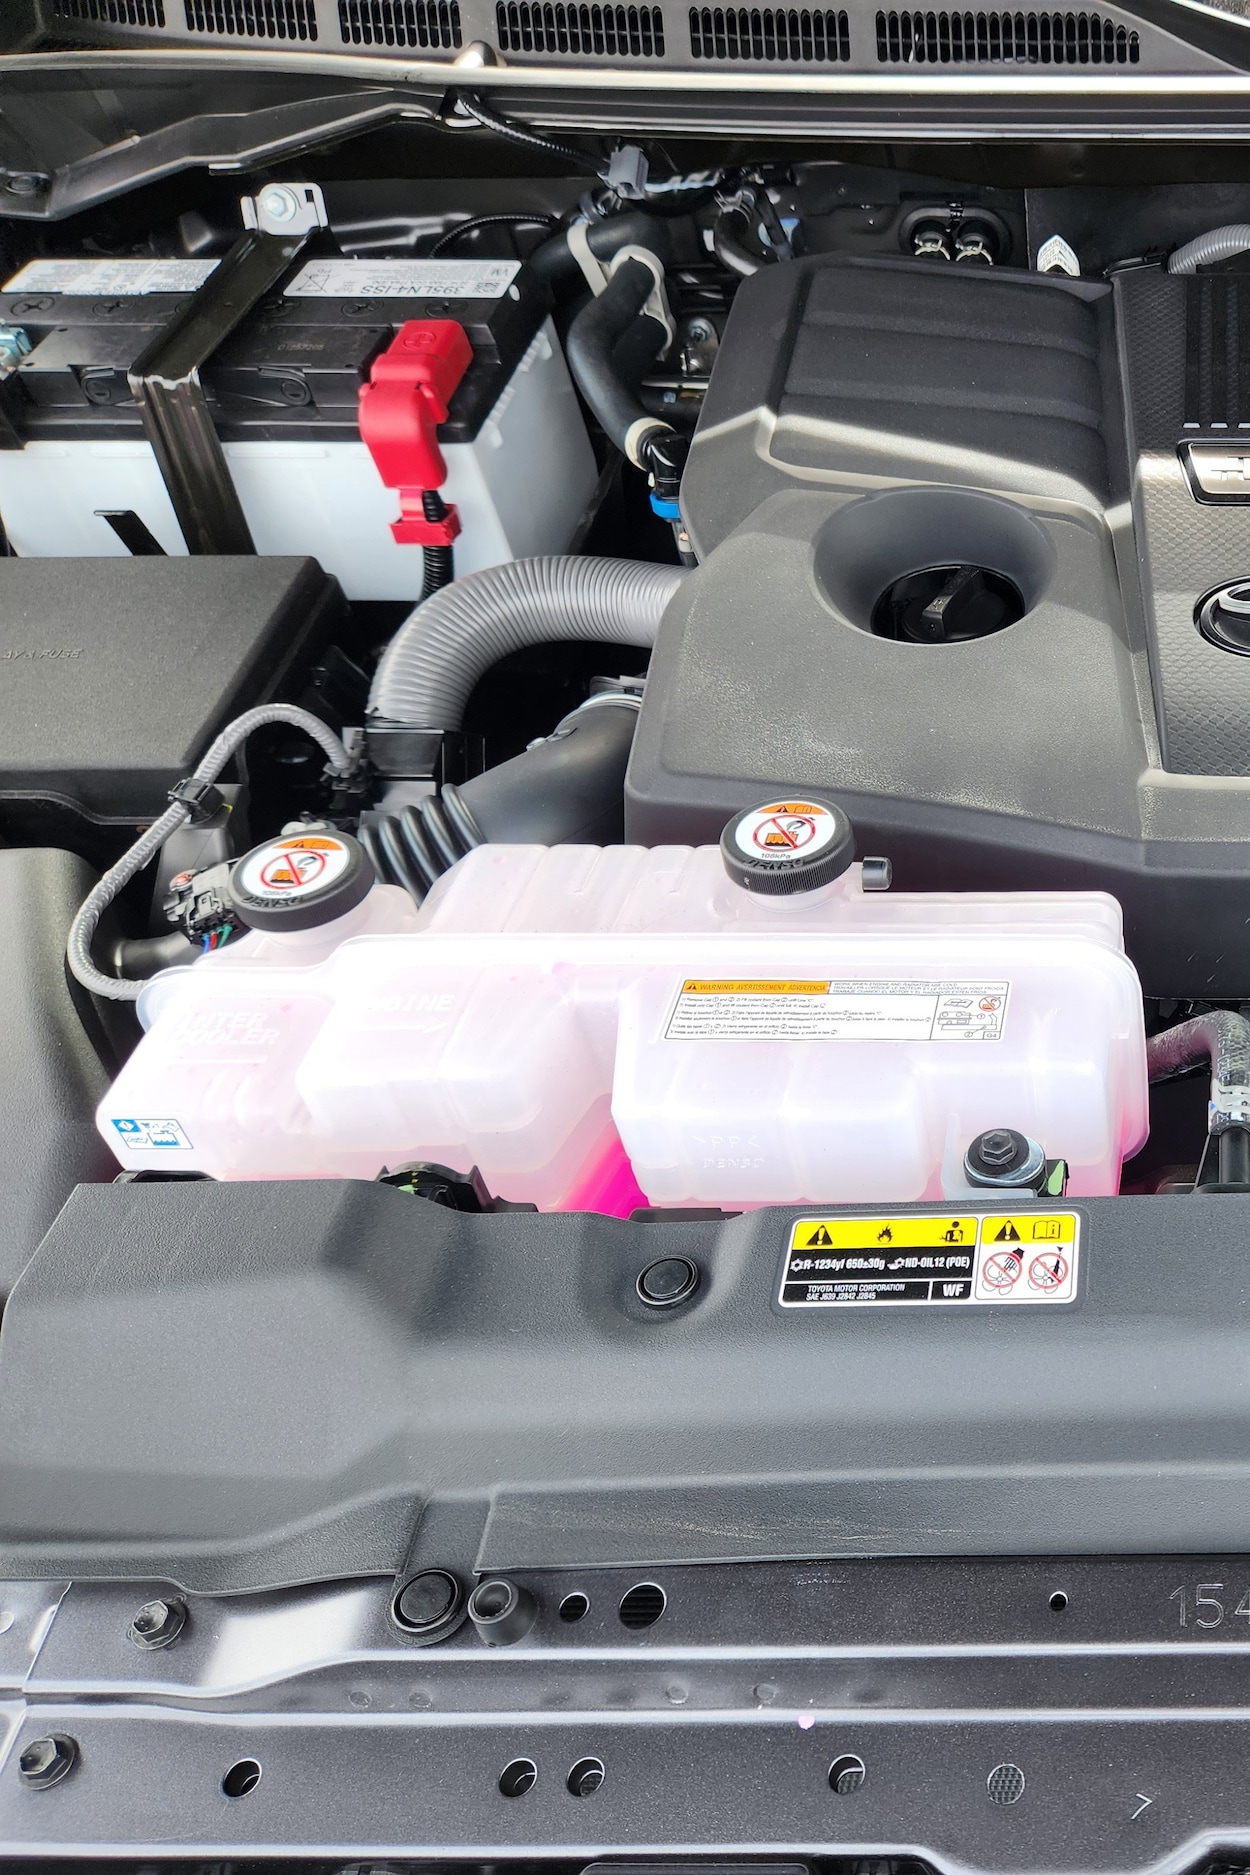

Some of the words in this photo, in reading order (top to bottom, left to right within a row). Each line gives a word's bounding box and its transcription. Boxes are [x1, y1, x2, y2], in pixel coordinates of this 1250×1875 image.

[744, 859, 804, 870] DENSO
[242, 896, 303, 908] DENSO
[703, 1158, 765, 1168] DENSO
[803, 1258, 846, 1271] R-1234yf
[846, 1257, 886, 1271] 650±30g
[904, 1257, 945, 1269] ND-OIL12
[946, 1256, 971, 1269] (POE)
[833, 1284, 858, 1292] MOTOR
[859, 1283, 906, 1292] CORPORATION
[942, 1283, 964, 1297] WF
[806, 1293, 819, 1301] SAE
[856, 1292, 876, 1300] J2845
